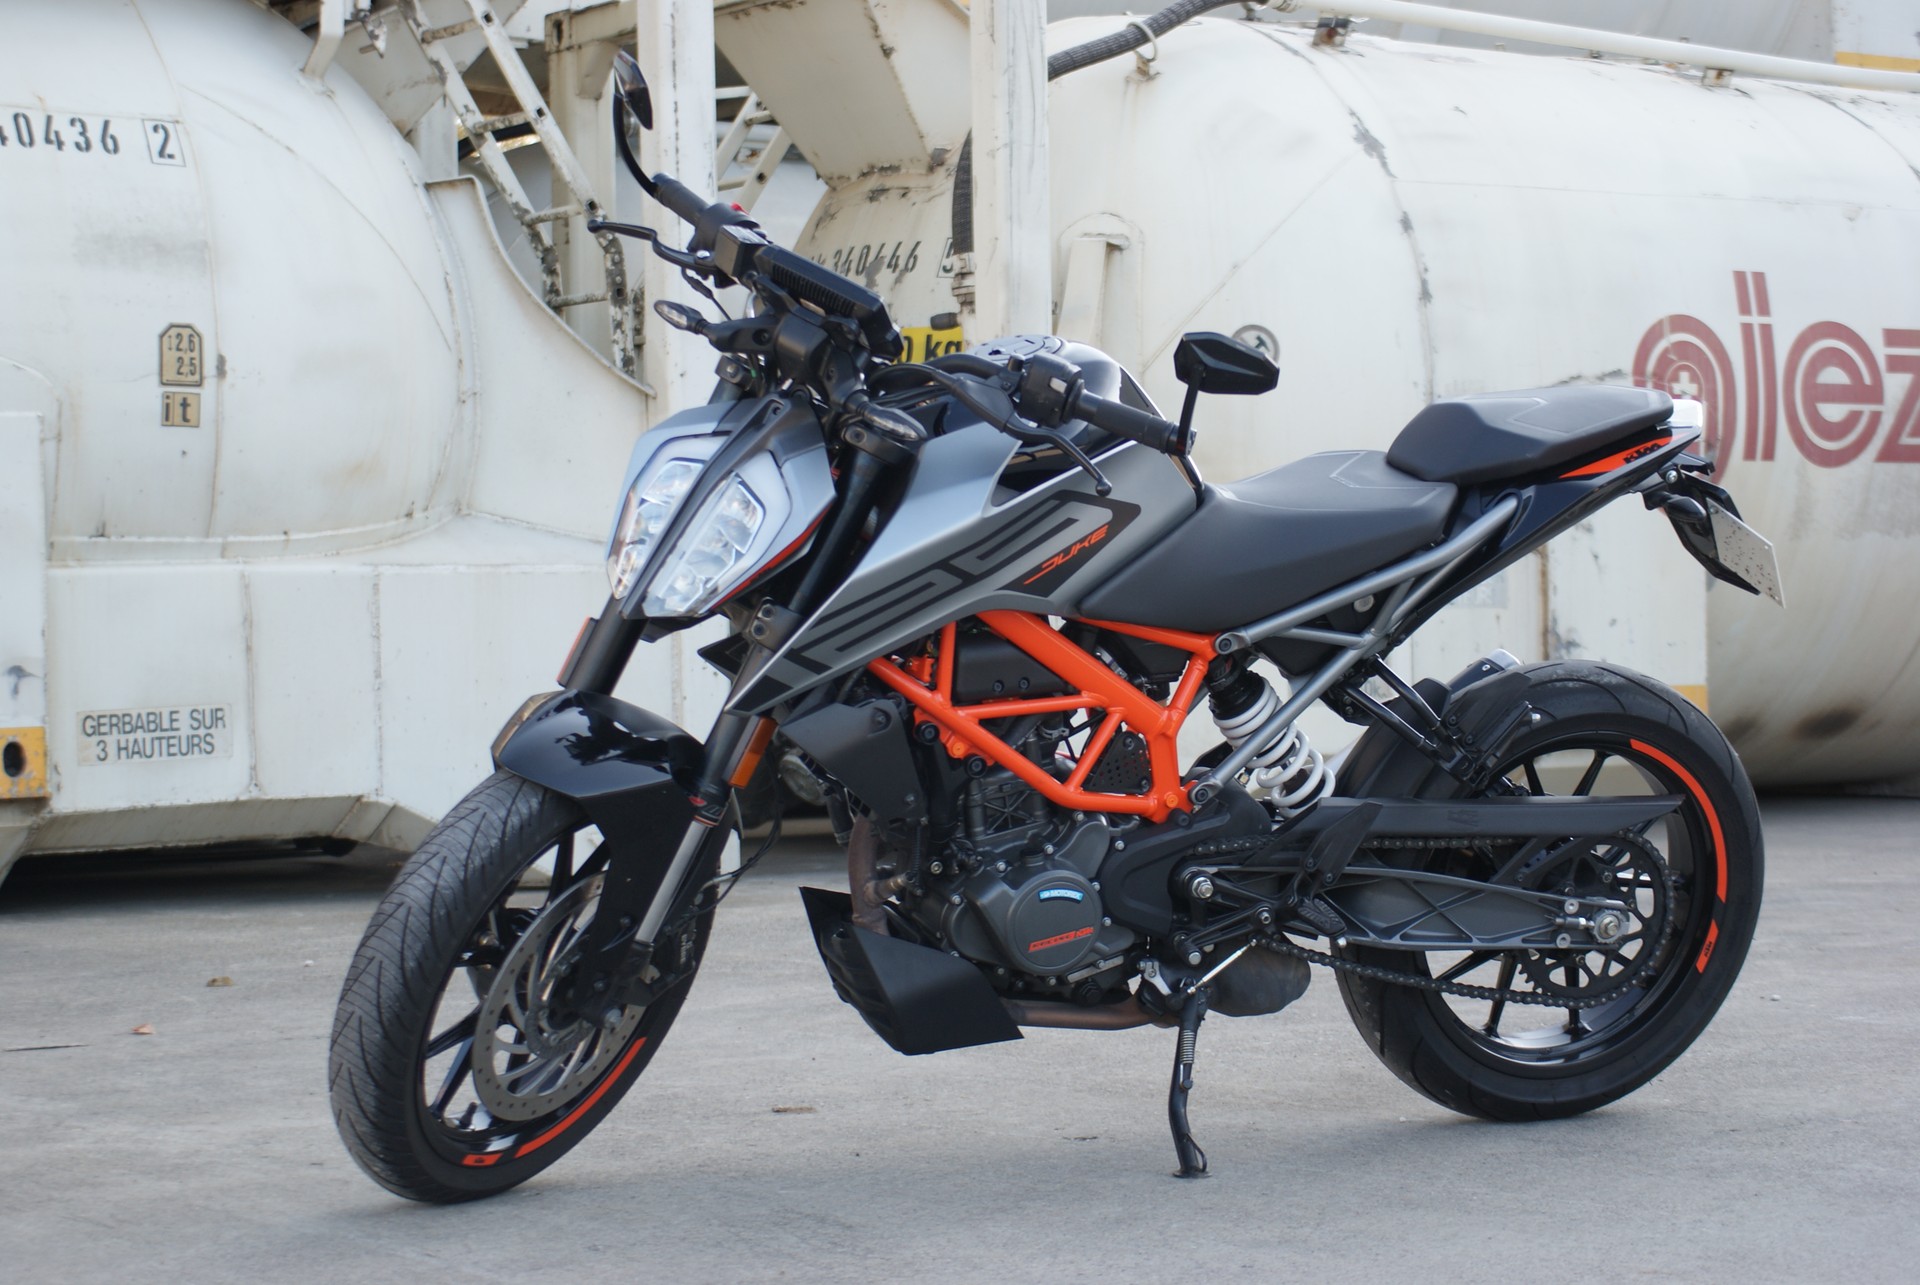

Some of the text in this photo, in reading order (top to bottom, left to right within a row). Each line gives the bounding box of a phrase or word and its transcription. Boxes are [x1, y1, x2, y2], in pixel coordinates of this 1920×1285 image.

[152, 123, 176, 160] 2
[175, 332, 196, 354] 2,6
[176, 355, 197, 378] 2,5
[1023, 524, 1109, 585] DUKE
[82, 708, 226, 737] GERBABLE SUR
[96, 732, 216, 761] 3 HAUTEURS
